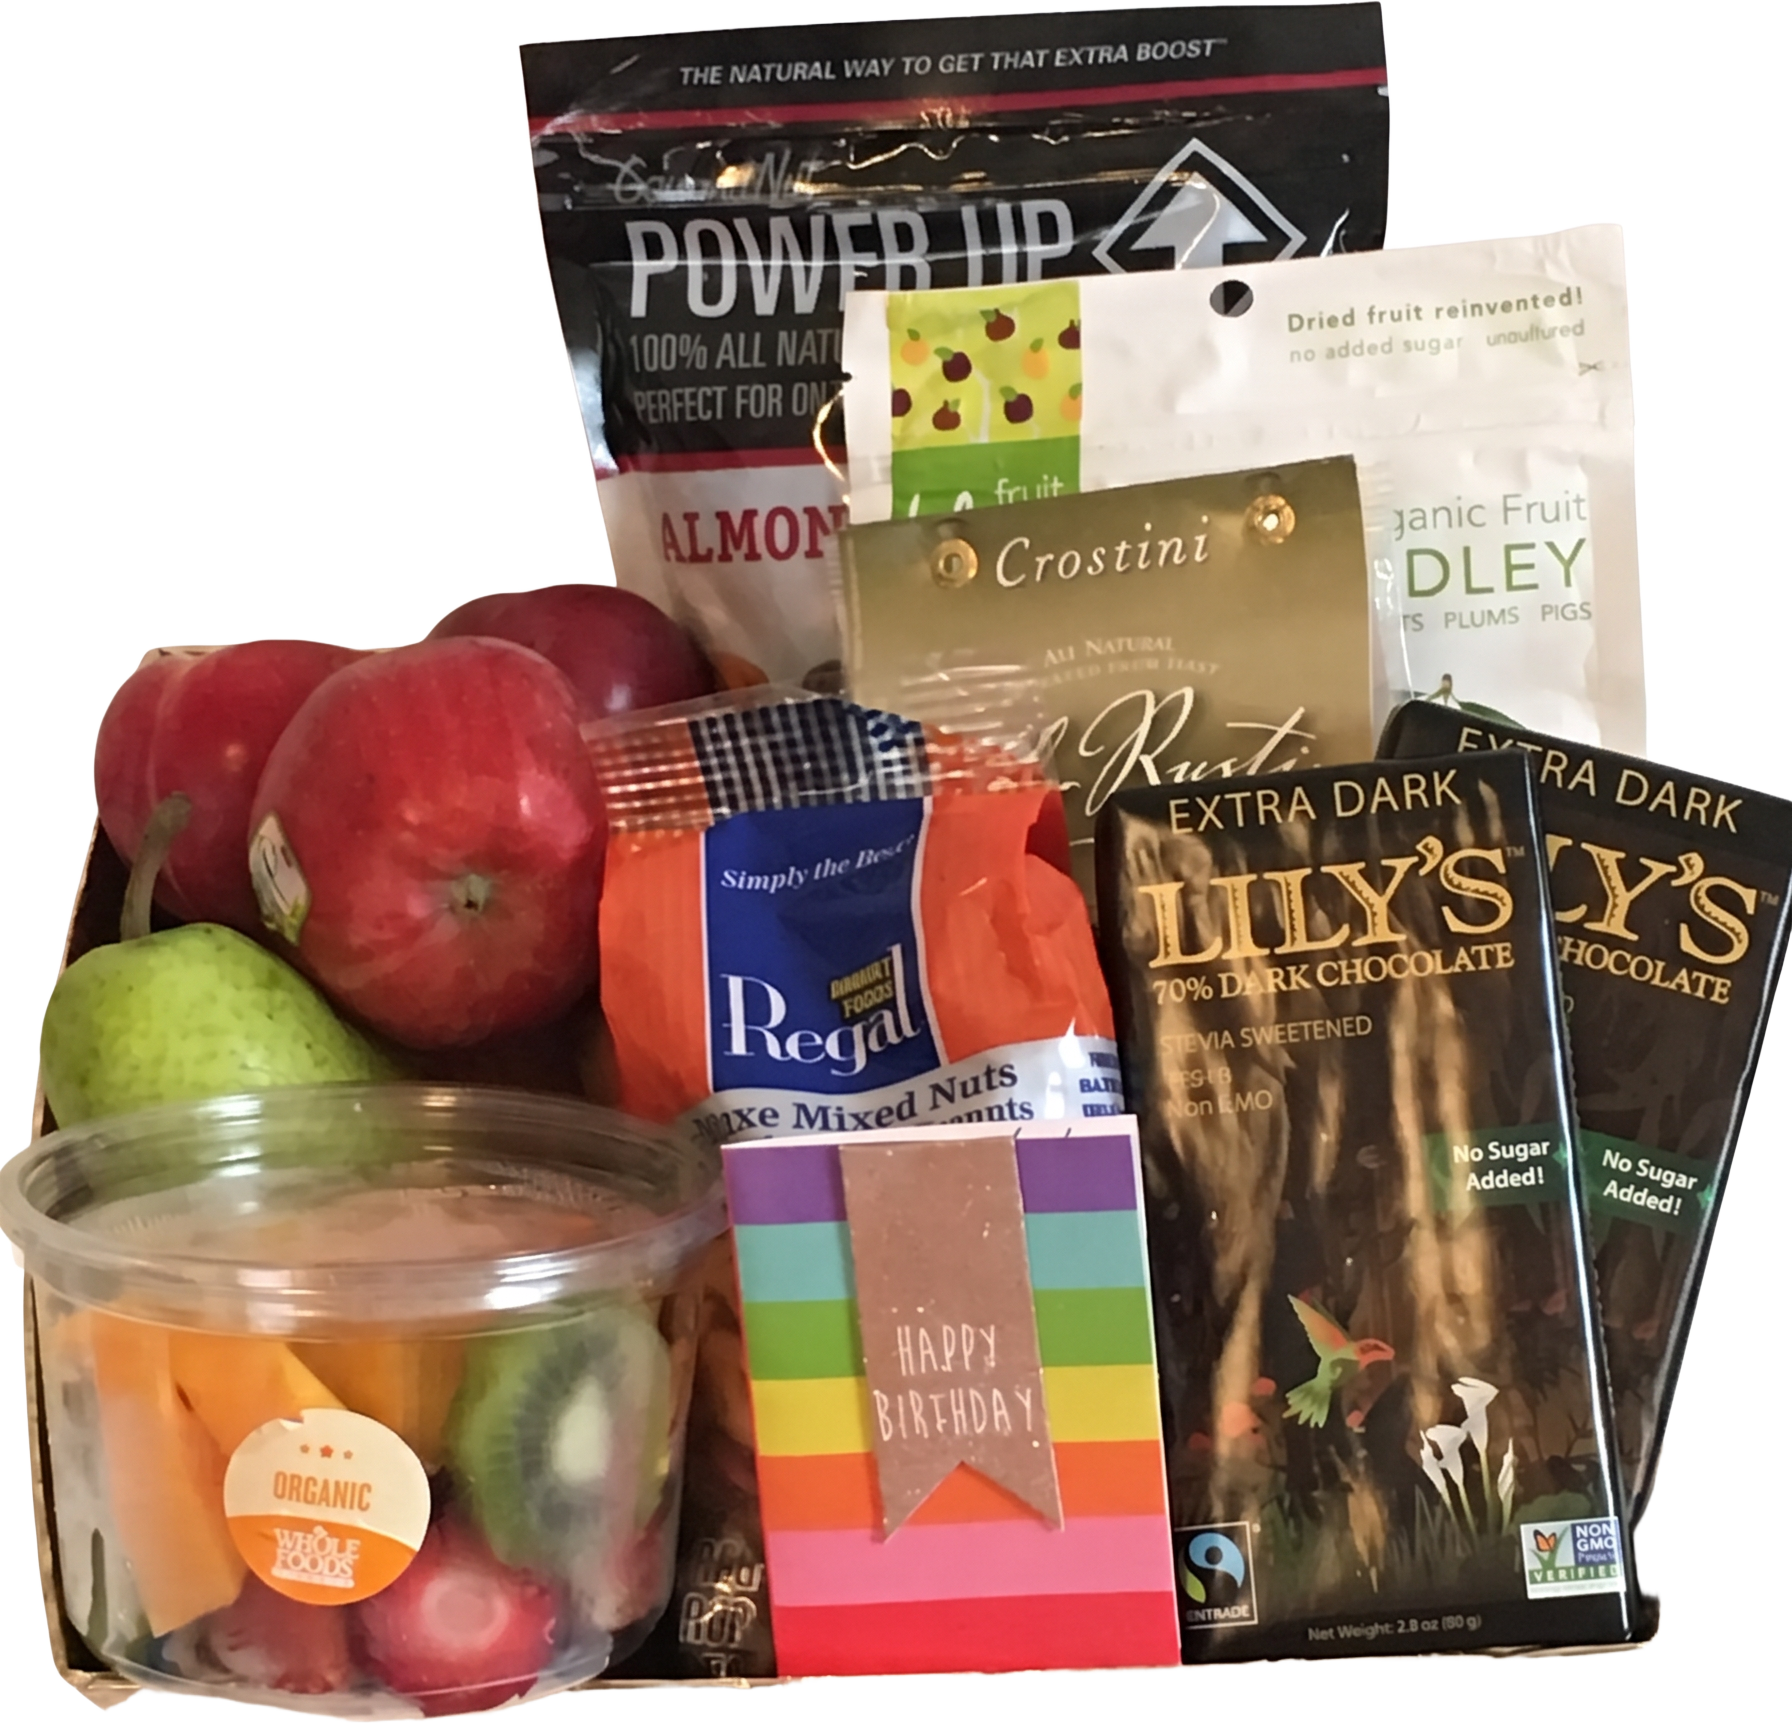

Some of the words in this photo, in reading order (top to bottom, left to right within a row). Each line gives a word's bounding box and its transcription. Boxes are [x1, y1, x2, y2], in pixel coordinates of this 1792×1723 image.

[680, 65, 723, 85] THE
[729, 60, 836, 84] NATURAL
[843, 57, 895, 78] WAY
[902, 56, 932, 76] TO
[938, 53, 984, 74] GET
[990, 49, 1050, 70] THAT
[1054, 44, 1129, 67] EXTRA
[1136, 38, 1217, 61] BOOST
[625, 209, 932, 319] POWER
[959, 199, 1075, 288] UP
[1287, 307, 1355, 333] Dried
[1367, 303, 1423, 325] fruit
[1435, 286, 1583, 320] reinvented!
[629, 333, 708, 373] 100%
[715, 332, 766, 369] ALL
[1289, 348, 1317, 363] no
[1325, 336, 1393, 360] added
[1403, 334, 1463, 356] sugar
[633, 386, 727, 424] PERFECT
[735, 382, 782, 420] FOR
[994, 474, 1064, 505] fruit
[1502, 490, 1587, 525] Fruit
[996, 514, 1209, 588] Crostini
[1406, 537, 1586, 598] DLEY
[1444, 606, 1520, 629] PLUMS
[1169, 785, 1317, 834] EXTRA
[1333, 769, 1462, 818] DARK
[1615, 769, 1743, 833] DARK
[721, 867, 808, 894] Simply
[814, 858, 850, 880] the
[1138, 835, 1514, 968] LILY'S
[1153, 975, 1213, 1005] 70%
[1220, 963, 1309, 1000] DARK
[1316, 941, 1515, 987] CHOCOLATE
[1558, 936, 1732, 1005] HOCOLATE
[720, 943, 920, 1076] Regal
[1240, 1015, 1373, 1047] SWEETENED
[792, 1089, 916, 1132] Mixed
[928, 1062, 1018, 1111] Nuts
[1453, 1144, 1484, 1163] No
[1488, 1141, 1550, 1162] Sugar
[1602, 1149, 1632, 1173] No
[1636, 1159, 1698, 1190] Sugar
[1466, 1166, 1544, 1191] Added!
[1603, 1179, 1682, 1216] Added!
[897, 1323, 996, 1377] HAPPY
[873, 1387, 1032, 1442] BIRTHDAY
[273, 1470, 372, 1512] ORGANIC
[273, 1526, 361, 1559] WHOLE
[1576, 1523, 1617, 1538] NON
[1577, 1536, 1617, 1551] GMO
[276, 1550, 354, 1577] FOODS
[1308, 1627, 1335, 1641] Net
[1337, 1622, 1394, 1640] Weight:
[1397, 1618, 1419, 1634] 2.8
[1421, 1619, 1439, 1632] oz
[1441, 1614, 1464, 1632] (80
[1466, 1614, 1482, 1631] g)
